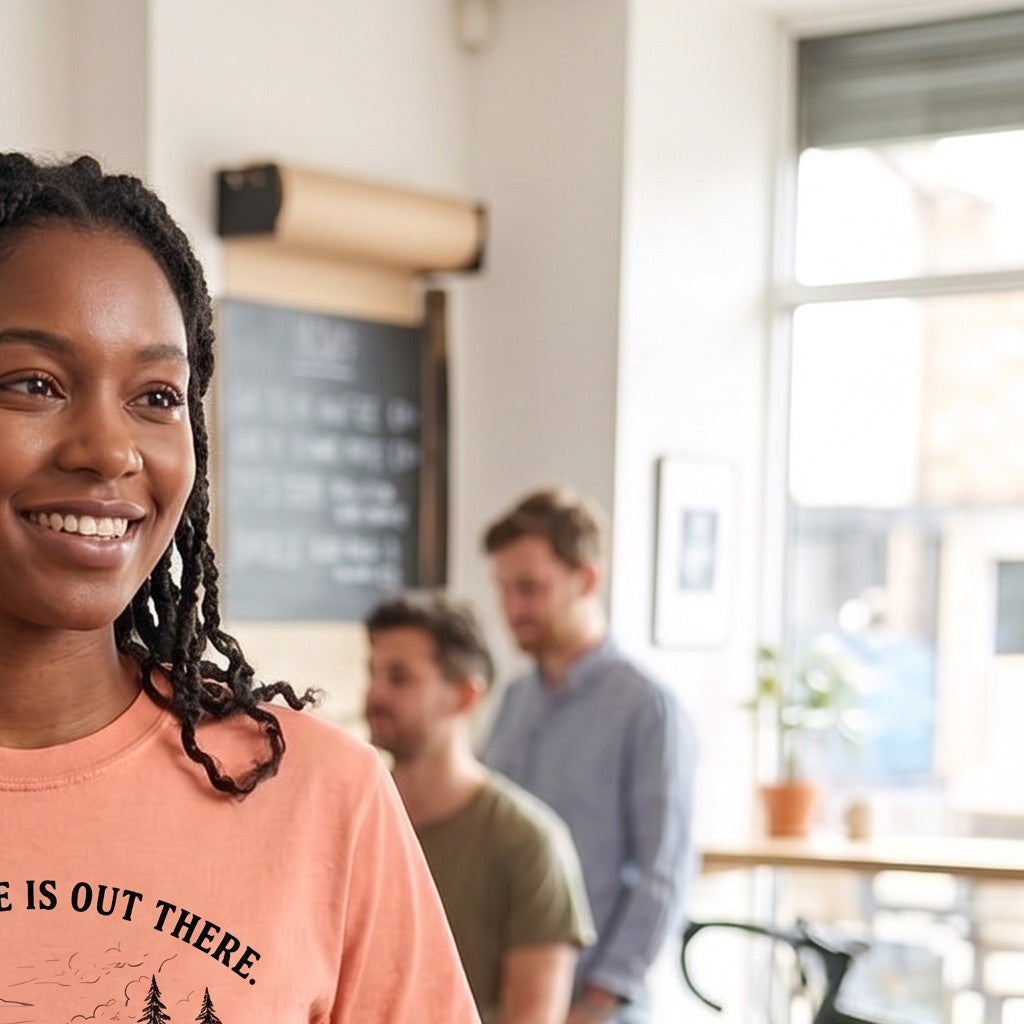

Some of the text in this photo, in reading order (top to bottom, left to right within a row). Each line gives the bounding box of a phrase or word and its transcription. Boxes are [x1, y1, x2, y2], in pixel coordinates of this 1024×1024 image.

[25, 879, 58, 911] IS
[70, 881, 144, 922] OUT
[153, 899, 262, 986] THERE.
